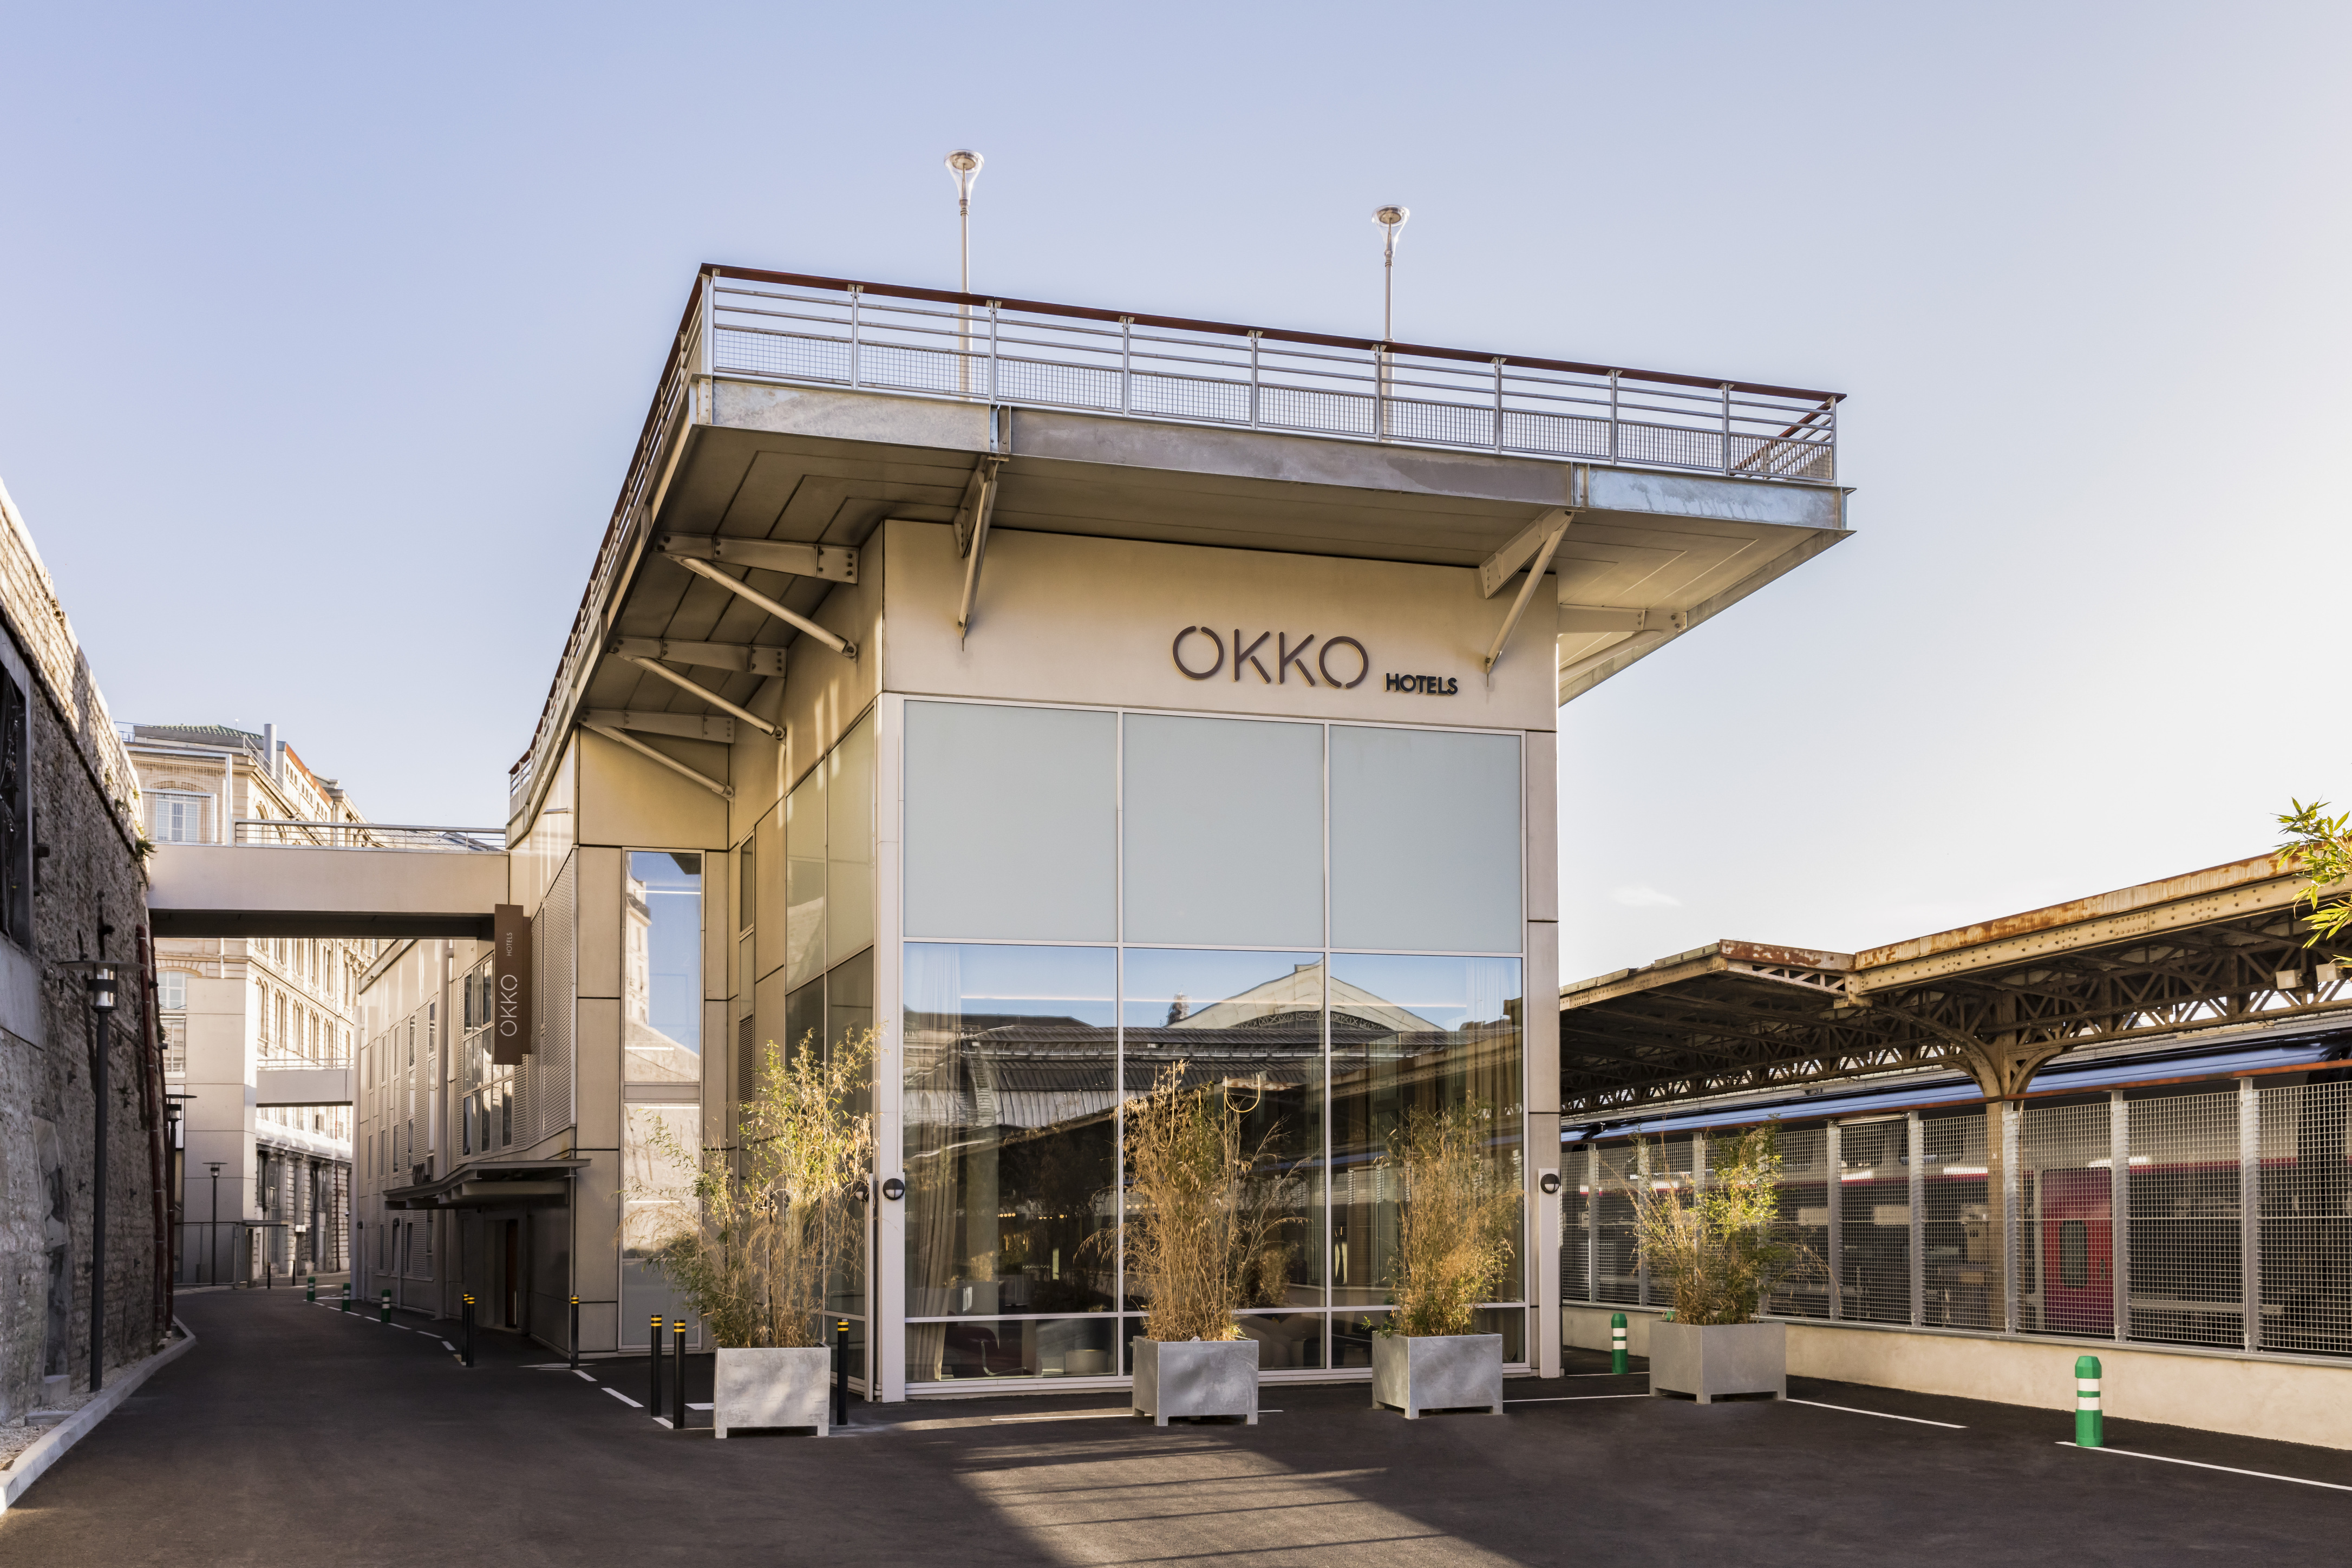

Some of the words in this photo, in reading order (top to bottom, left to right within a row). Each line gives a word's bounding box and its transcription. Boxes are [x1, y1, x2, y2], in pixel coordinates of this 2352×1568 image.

[1172, 625, 1369, 689] OKKO
[1384, 672, 1459, 696] HOTELS
[500, 975, 518, 1036] OKKO
